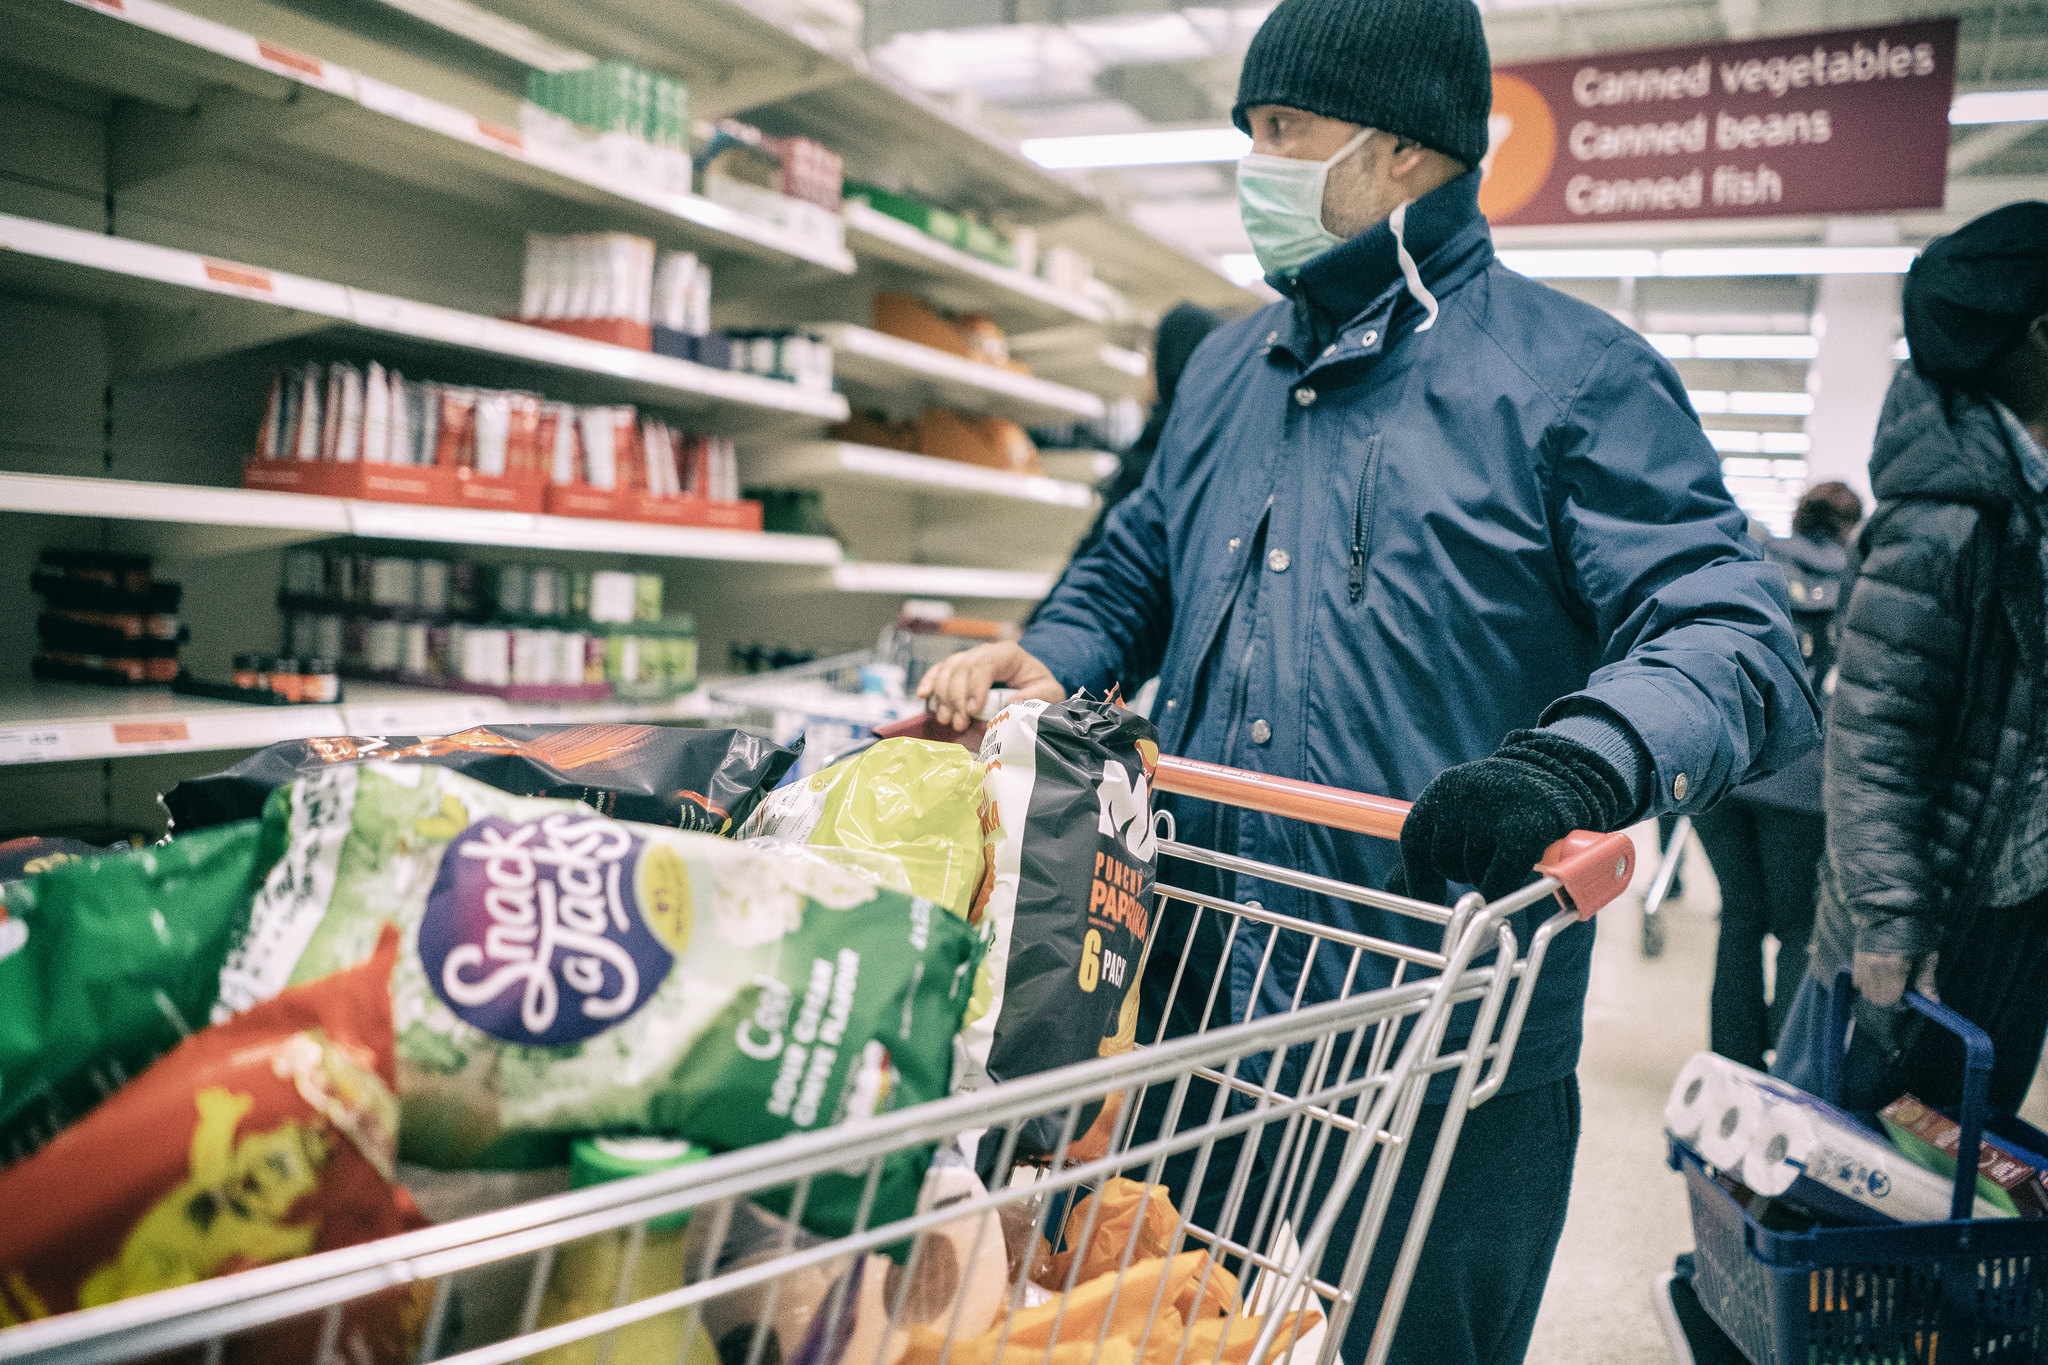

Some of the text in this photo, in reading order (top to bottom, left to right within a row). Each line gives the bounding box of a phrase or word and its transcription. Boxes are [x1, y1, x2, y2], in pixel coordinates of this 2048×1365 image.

[1572, 40, 1935, 106] Canned vegetables
[1569, 108, 1833, 160] Canned beans
[1566, 163, 1783, 216] Canned fish
[1095, 851, 1143, 898] PUNCHY
[442, 823, 546, 1008] Snack
[533, 813, 640, 1019] Jacks
[1089, 879, 1149, 943] PAPRIKA
[1078, 928, 1127, 993] 6 PACK
